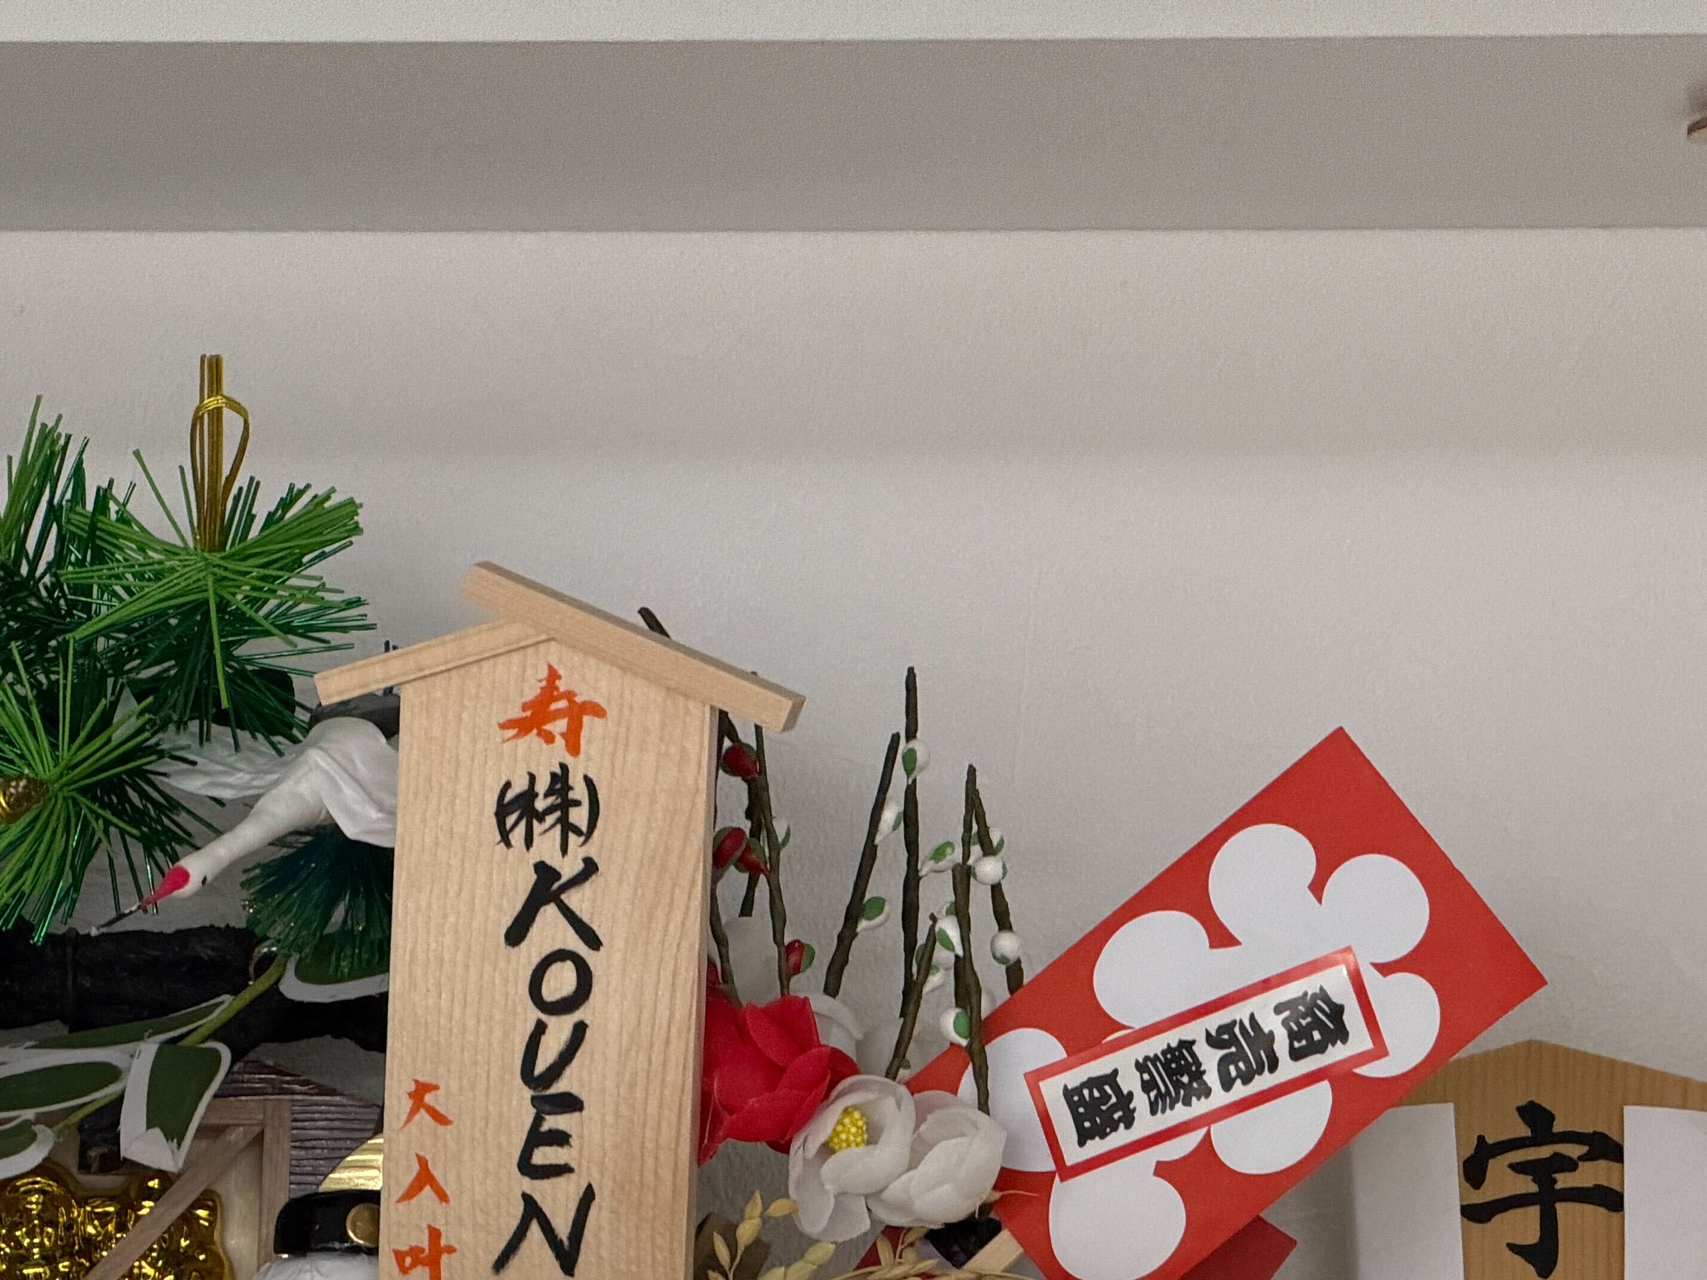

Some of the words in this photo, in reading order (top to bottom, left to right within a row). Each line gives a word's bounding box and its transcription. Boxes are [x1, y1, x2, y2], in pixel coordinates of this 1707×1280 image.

[498, 663, 607, 757] 寿
[1063, 985, 1349, 1148] 商売繁盛
